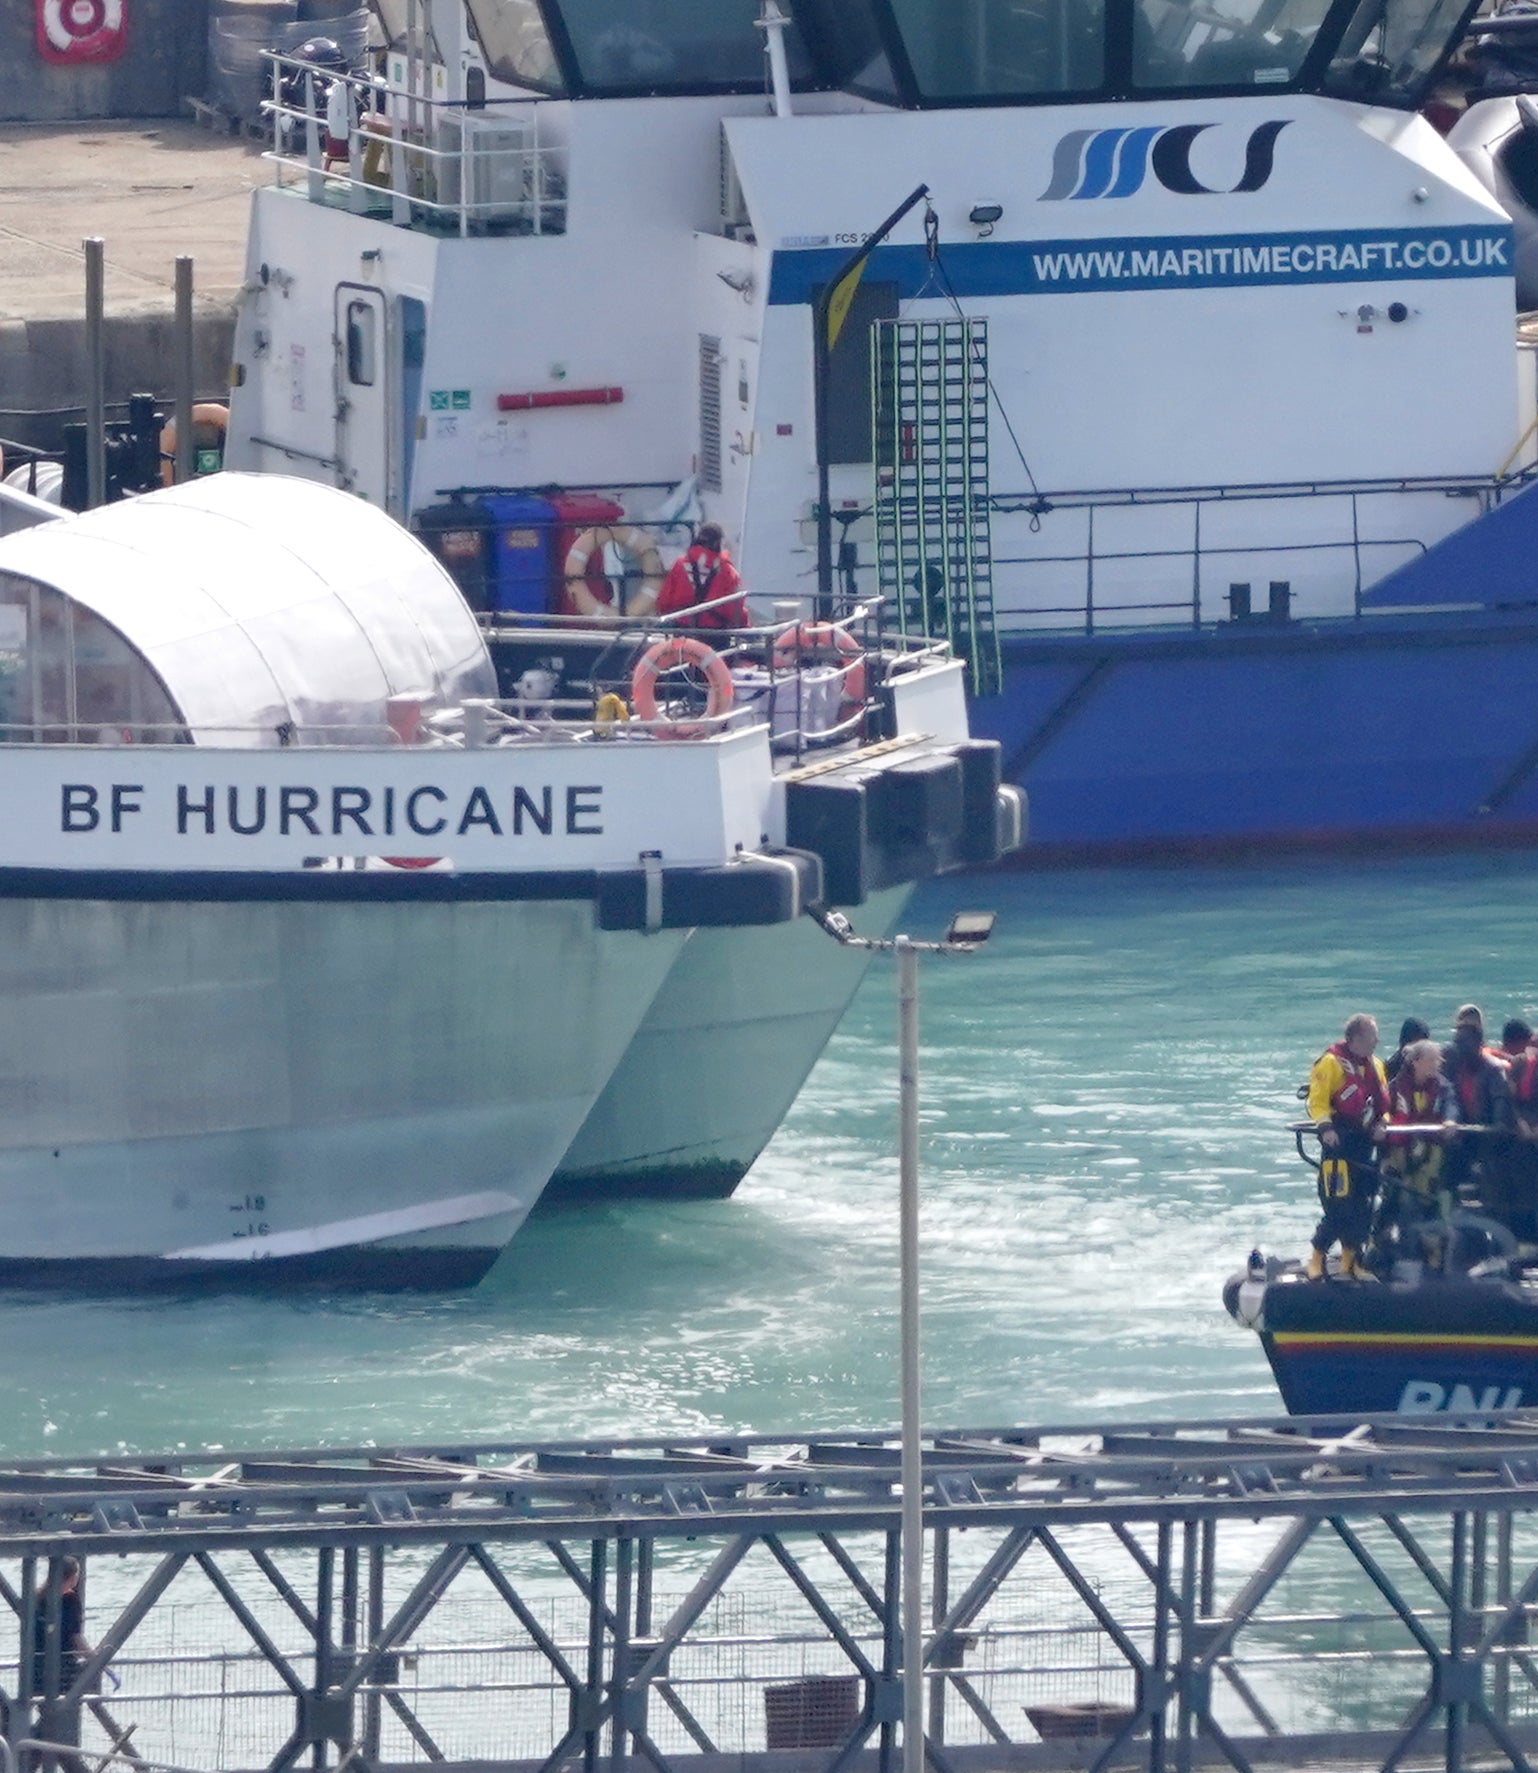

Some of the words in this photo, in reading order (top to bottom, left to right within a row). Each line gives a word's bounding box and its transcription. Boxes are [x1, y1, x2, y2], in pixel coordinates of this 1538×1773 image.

[834, 232, 858, 244] FCS
[1032, 237, 1508, 281] WWW.MARITIMECRAFT.CO.UK
[60, 783, 145, 833] BF
[176, 784, 605, 836] HURRICANE
